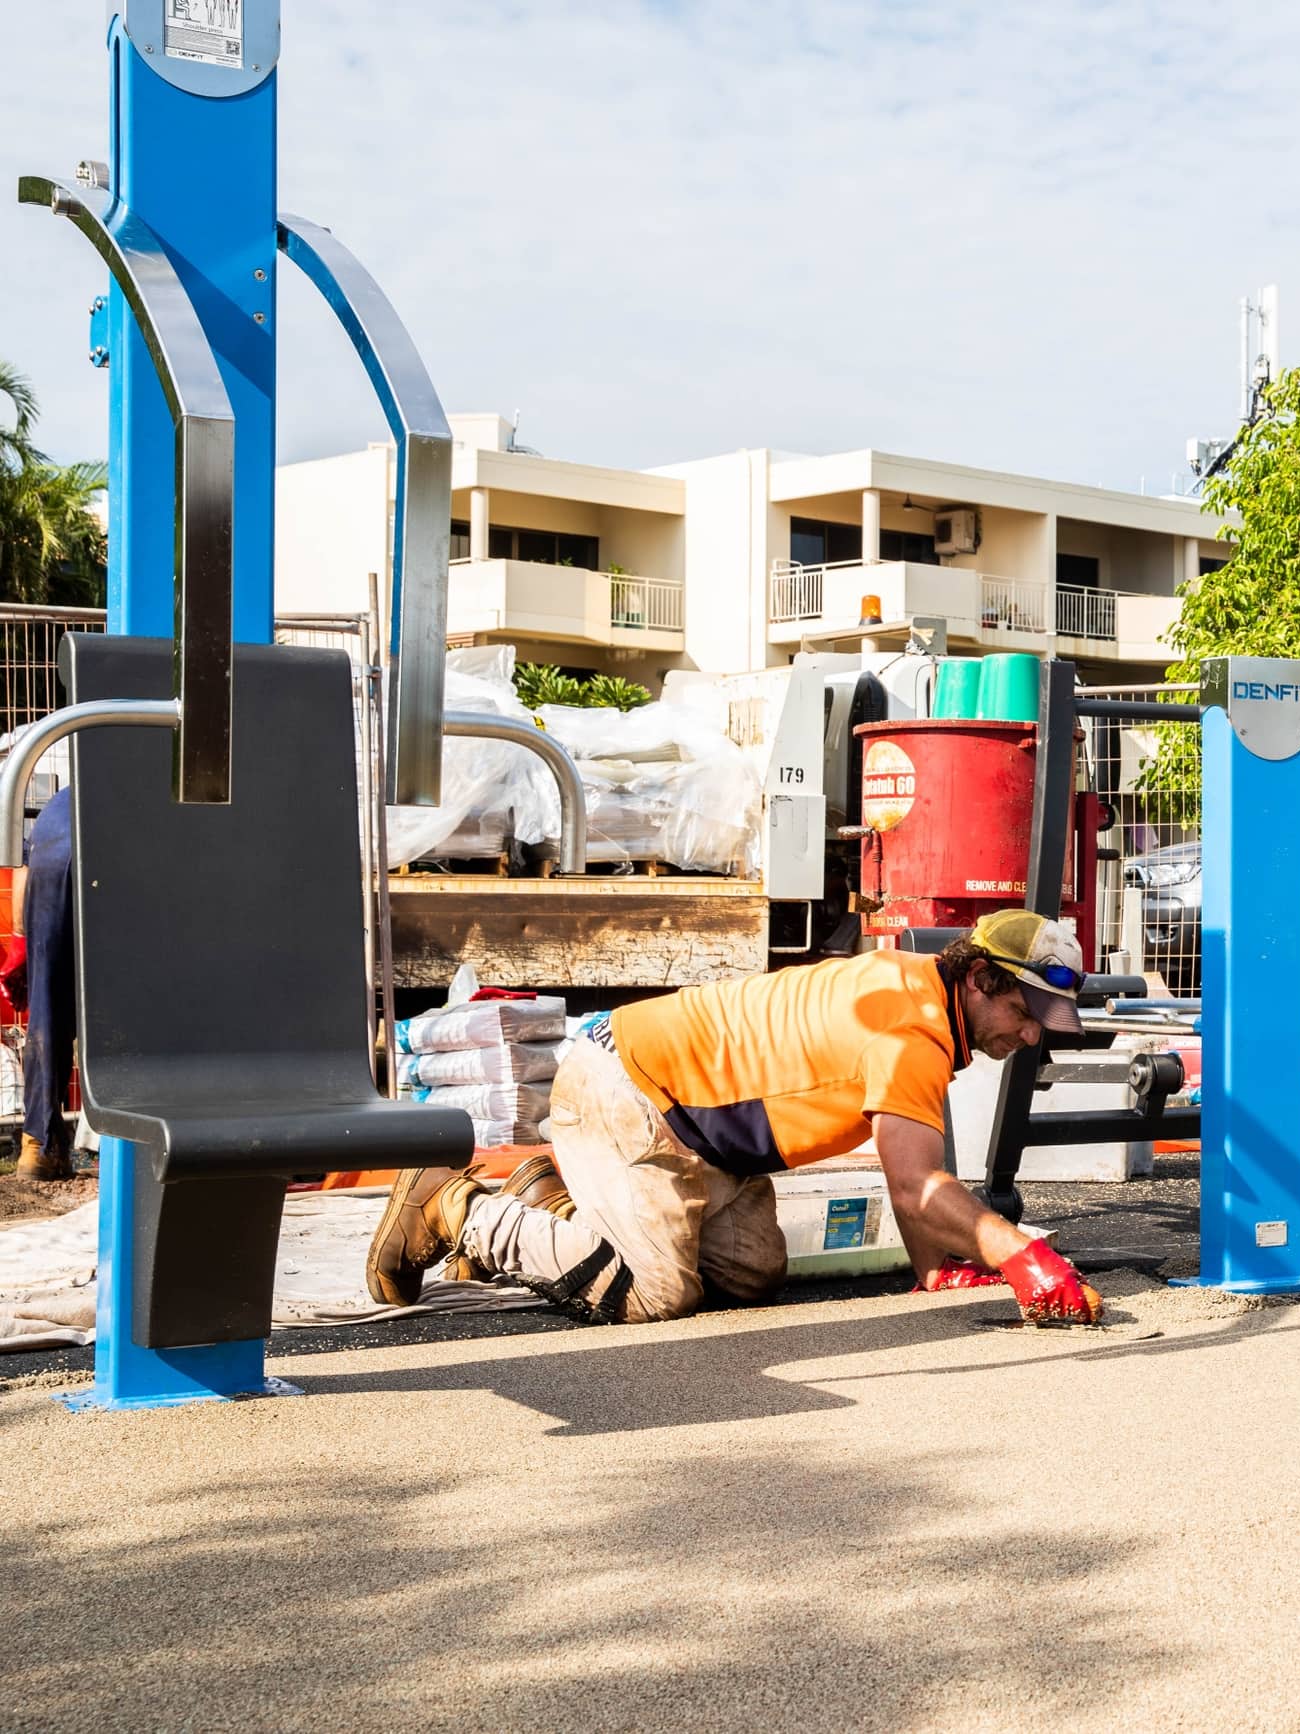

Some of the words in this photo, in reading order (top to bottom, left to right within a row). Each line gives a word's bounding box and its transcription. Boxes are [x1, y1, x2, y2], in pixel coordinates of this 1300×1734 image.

[780, 767, 804, 783] 179
[896, 775, 915, 795] 60
[965, 880, 996, 892] REMOVE
[997, 881, 1012, 893] AND
[1013, 881, 1028, 893] CLE
